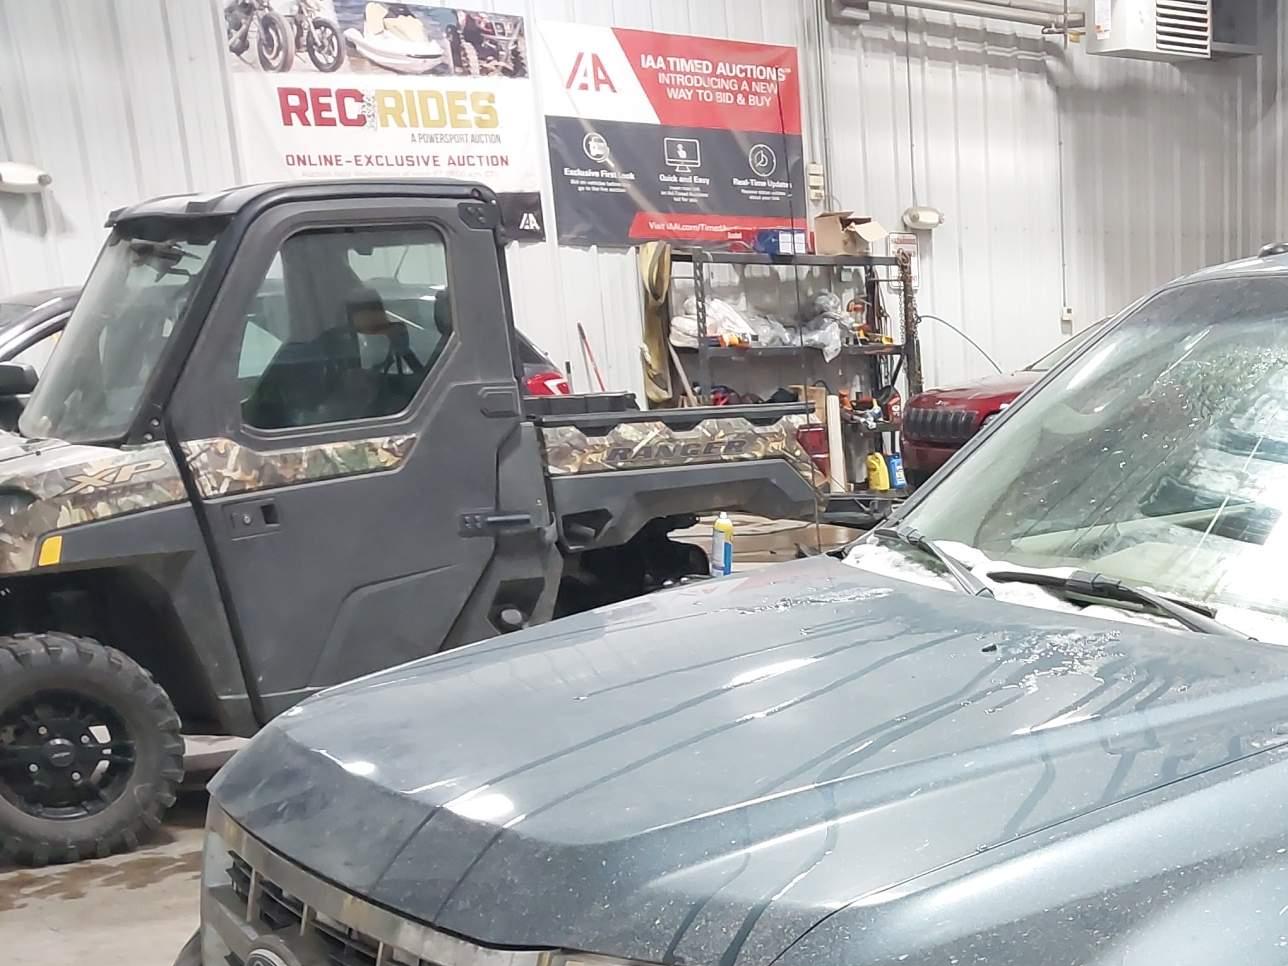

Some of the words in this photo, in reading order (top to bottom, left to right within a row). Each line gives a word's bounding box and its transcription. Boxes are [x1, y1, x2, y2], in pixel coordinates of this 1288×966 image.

[640, 53, 666, 70] IAA
[667, 57, 712, 74] TIMED
[658, 73, 738, 91] INTRODUCING
[741, 80, 750, 92] A
[752, 81, 777, 94] NEW
[667, 88, 693, 100] WAY
[696, 90, 713, 102] TO
[716, 92, 733, 103] BID
[737, 93, 745, 105] &
[749, 95, 771, 106] BUY
[277, 87, 367, 127] REC
[374, 89, 499, 129] RIDES
[411, 133, 417, 143] A
[418, 133, 468, 144] POWERSPORT
[470, 134, 502, 144] AUCTION
[285, 154, 441, 167] ONLINE-EXCLUSIVE
[447, 155, 509, 167] AUCTION
[563, 168, 600, 178] Exclusive
[659, 174, 677, 182] Quick
[679, 175, 692, 183] and
[694, 176, 710, 185] Easy
[732, 178, 766, 187] Real-Time
[648, 221, 664, 230] Visit
[607, 438, 746, 461] RANGER
[60, 459, 167, 495] XP
